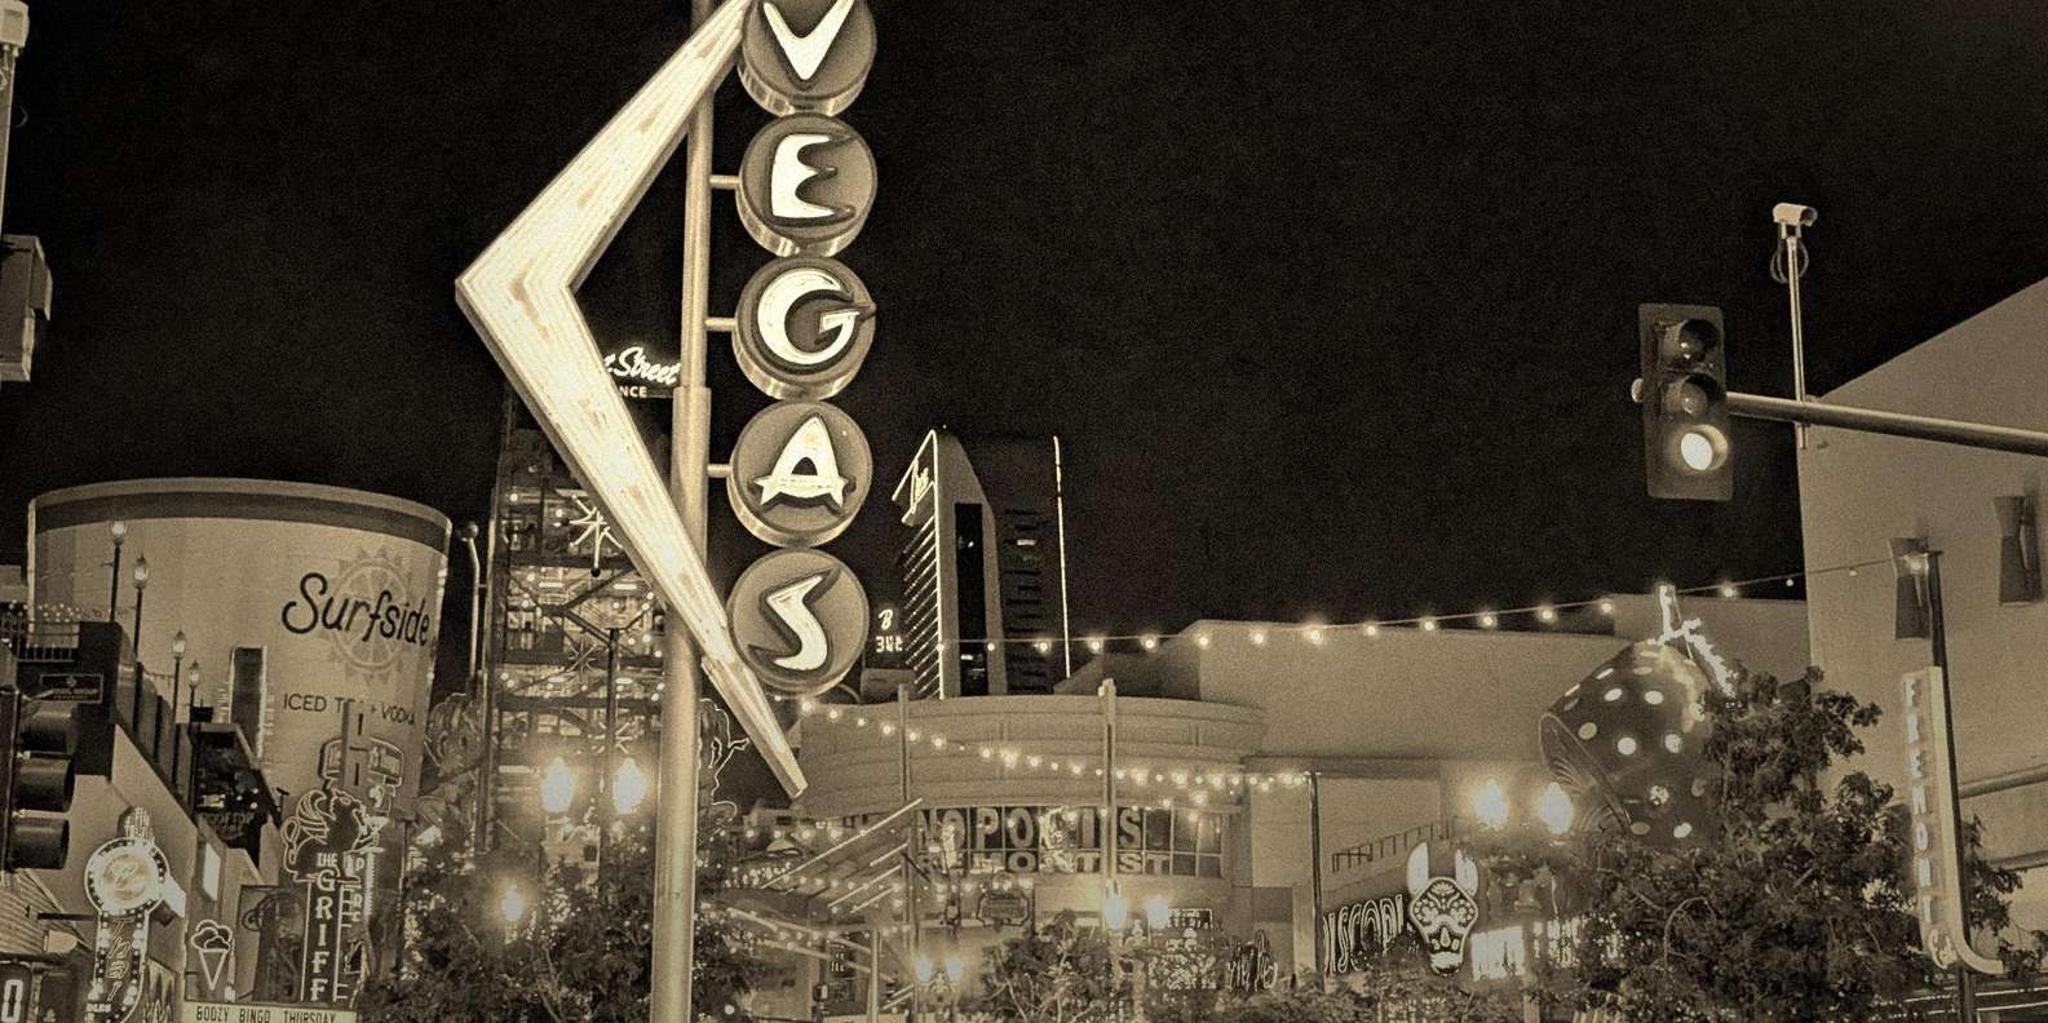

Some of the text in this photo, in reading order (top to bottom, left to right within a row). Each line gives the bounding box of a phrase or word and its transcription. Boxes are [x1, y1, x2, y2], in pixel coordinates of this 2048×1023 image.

[757, 0, 860, 672] VEGAS
[613, 346, 681, 386] Street
[282, 572, 430, 646] Surfside
[284, 693, 327, 712] ICED
[316, 852, 338, 867] THE
[310, 869, 335, 1001] GRIFF
[195, 1005, 336, 1023] BOOZY BINGO THURSDAY
